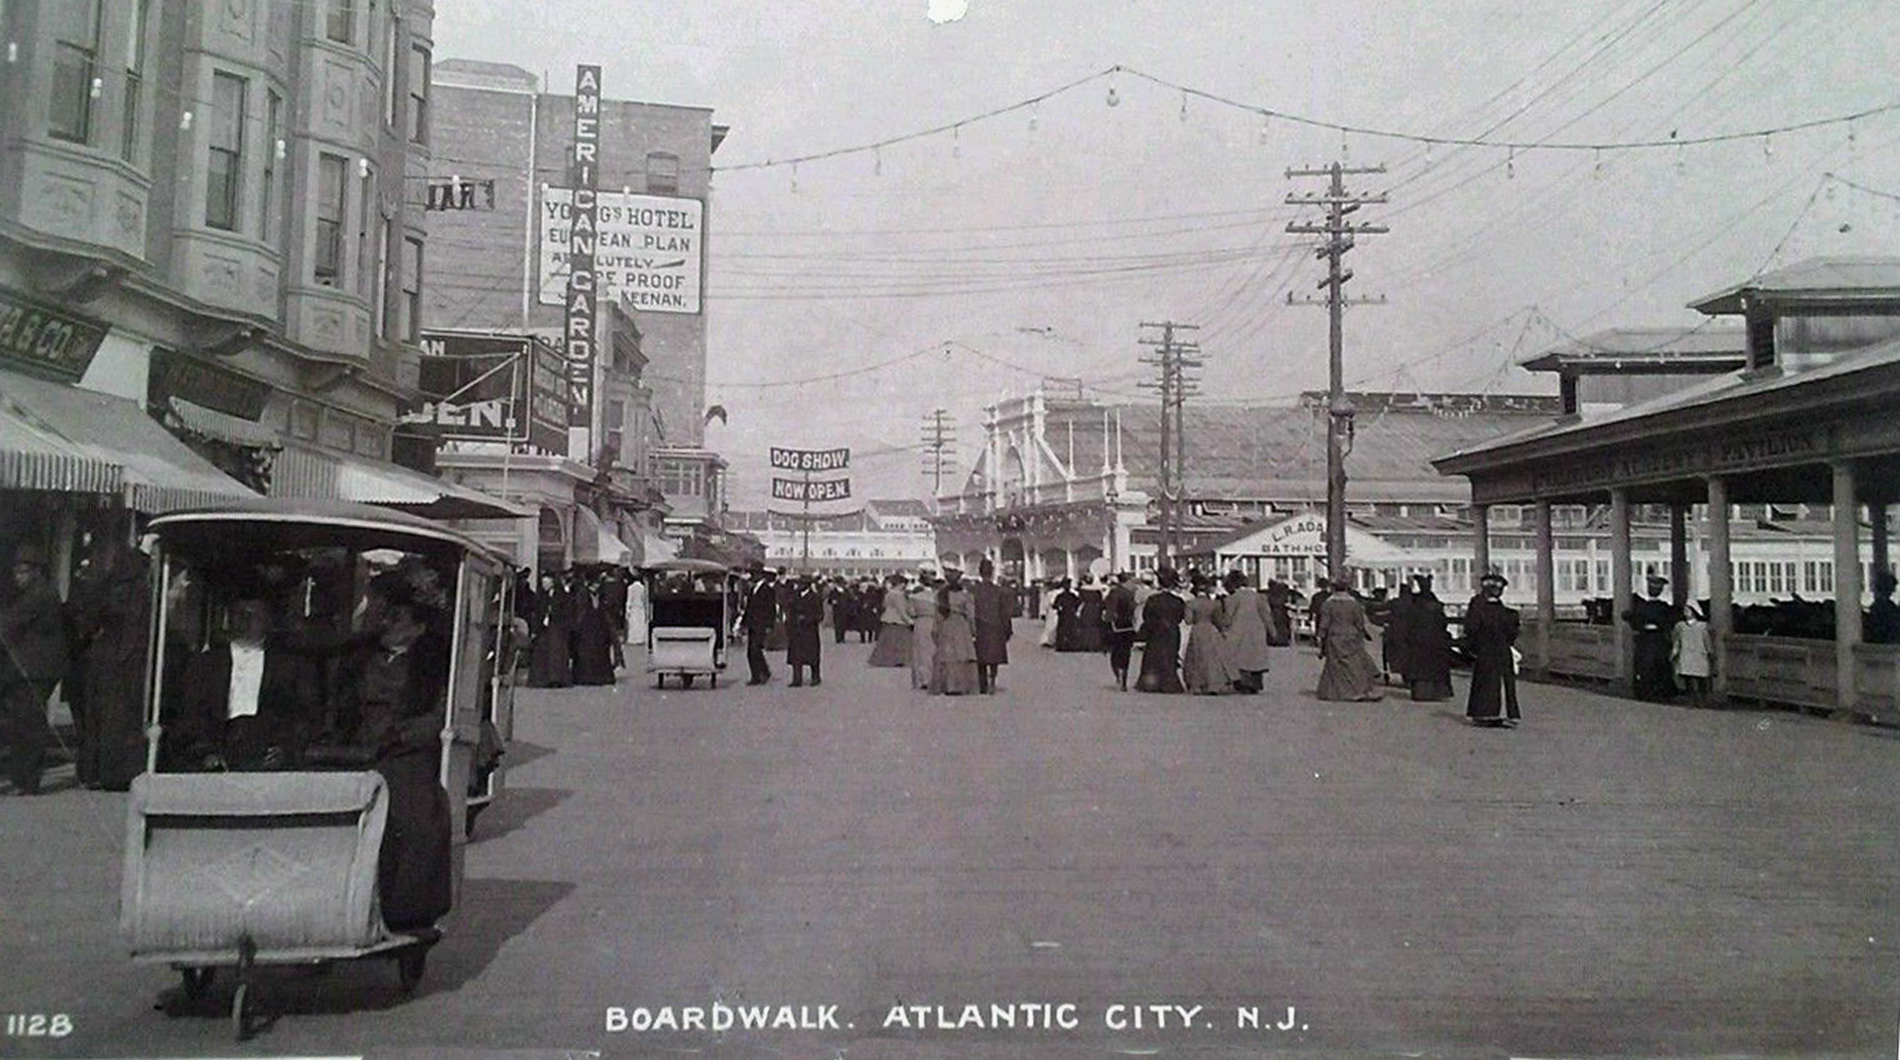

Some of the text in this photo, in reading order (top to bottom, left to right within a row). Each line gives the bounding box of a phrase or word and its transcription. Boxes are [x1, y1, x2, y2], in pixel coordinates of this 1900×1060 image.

[573, 70, 598, 254] AMERICAN
[628, 207, 694, 230] HOTEL
[549, 228, 690, 252] EUEAN PLAN
[626, 272, 685, 290] PROOF
[773, 449, 799, 467] DOG
[775, 480, 806, 498] NOW
